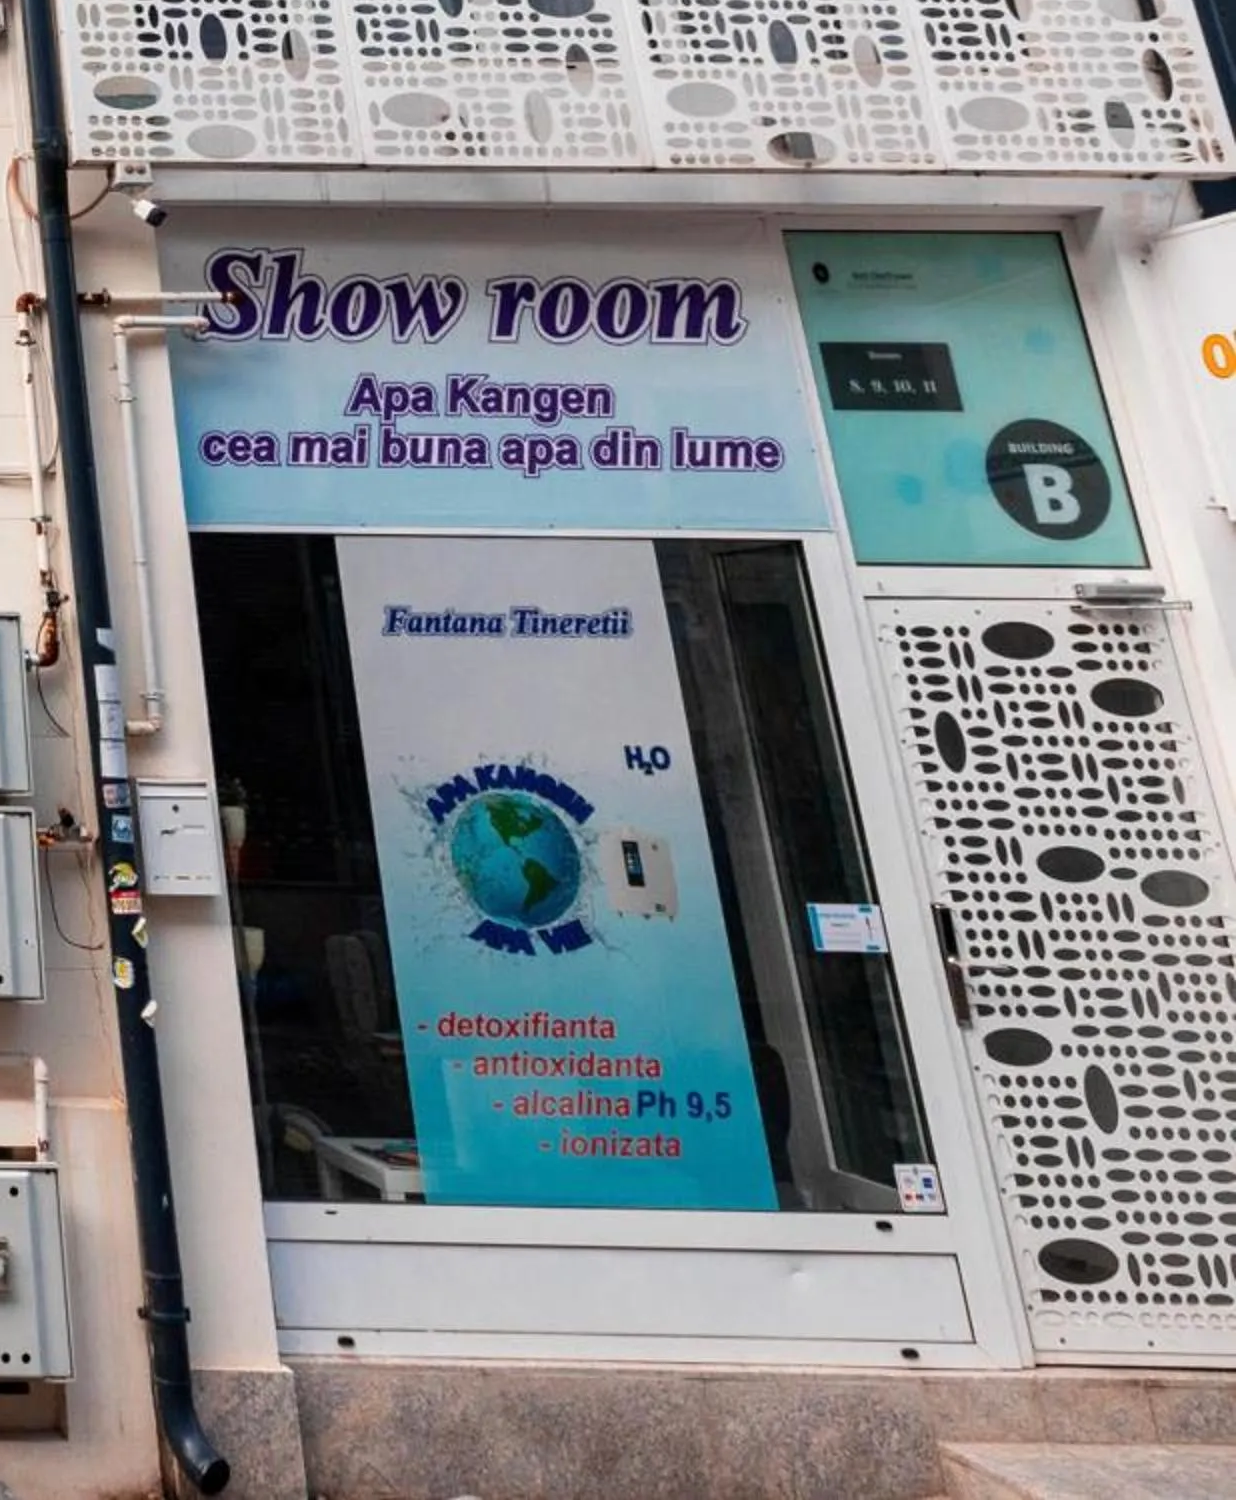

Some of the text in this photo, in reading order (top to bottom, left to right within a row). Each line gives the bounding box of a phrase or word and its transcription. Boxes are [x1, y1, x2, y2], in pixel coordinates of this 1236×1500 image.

[196, 247, 745, 343] Show room
[346, 374, 614, 425] Apa Kangen
[199, 424, 784, 478] cea mai buna apa din lume
[1007, 441, 1075, 456] BUILDING
[1022, 462, 1081, 525] B
[384, 606, 631, 636] Fantana Tineretii
[426, 764, 595, 824] APA KANGEN
[469, 919, 536, 956] APA
[437, 1012, 616, 1040] detoxifianta
[473, 1052, 662, 1079] antioxidanta
[512, 1090, 631, 1117] alcalina
[636, 1089, 677, 1118] Ph
[686, 1091, 733, 1124] 9,5
[559, 1131, 682, 1158] ionizata
